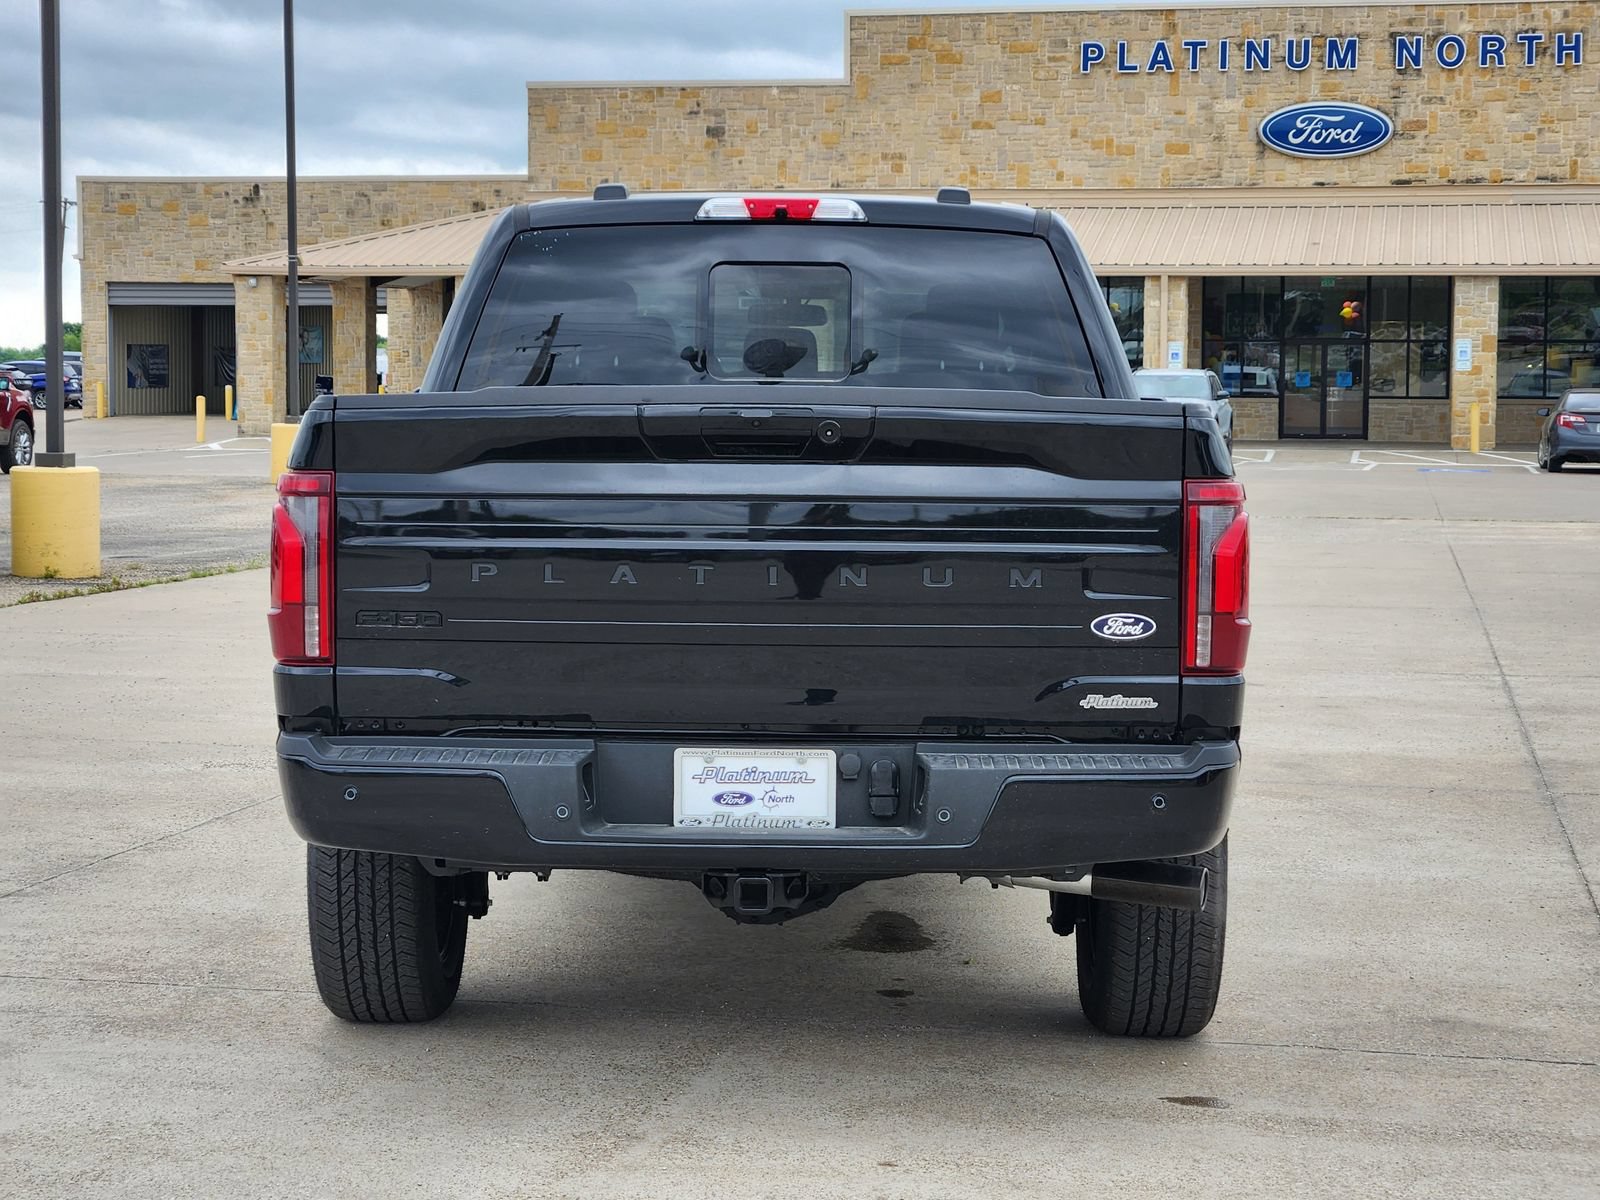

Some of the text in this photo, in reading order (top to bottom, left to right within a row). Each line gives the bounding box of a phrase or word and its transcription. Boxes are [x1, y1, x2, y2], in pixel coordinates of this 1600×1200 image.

[1080, 31, 1583, 74] PLATINUM NORTH
[1287, 113, 1364, 145] Ford
[471, 562, 1044, 589] PLATINUM
[1103, 617, 1145, 635] Ford
[1080, 694, 1158, 709] Platinum
[682, 749, 829, 757] www.PlatinumFordNorth.com
[692, 766, 816, 784] Platinum
[720, 793, 747, 806] Ford
[767, 794, 795, 804] North
[712, 813, 802, 830] Platinum
